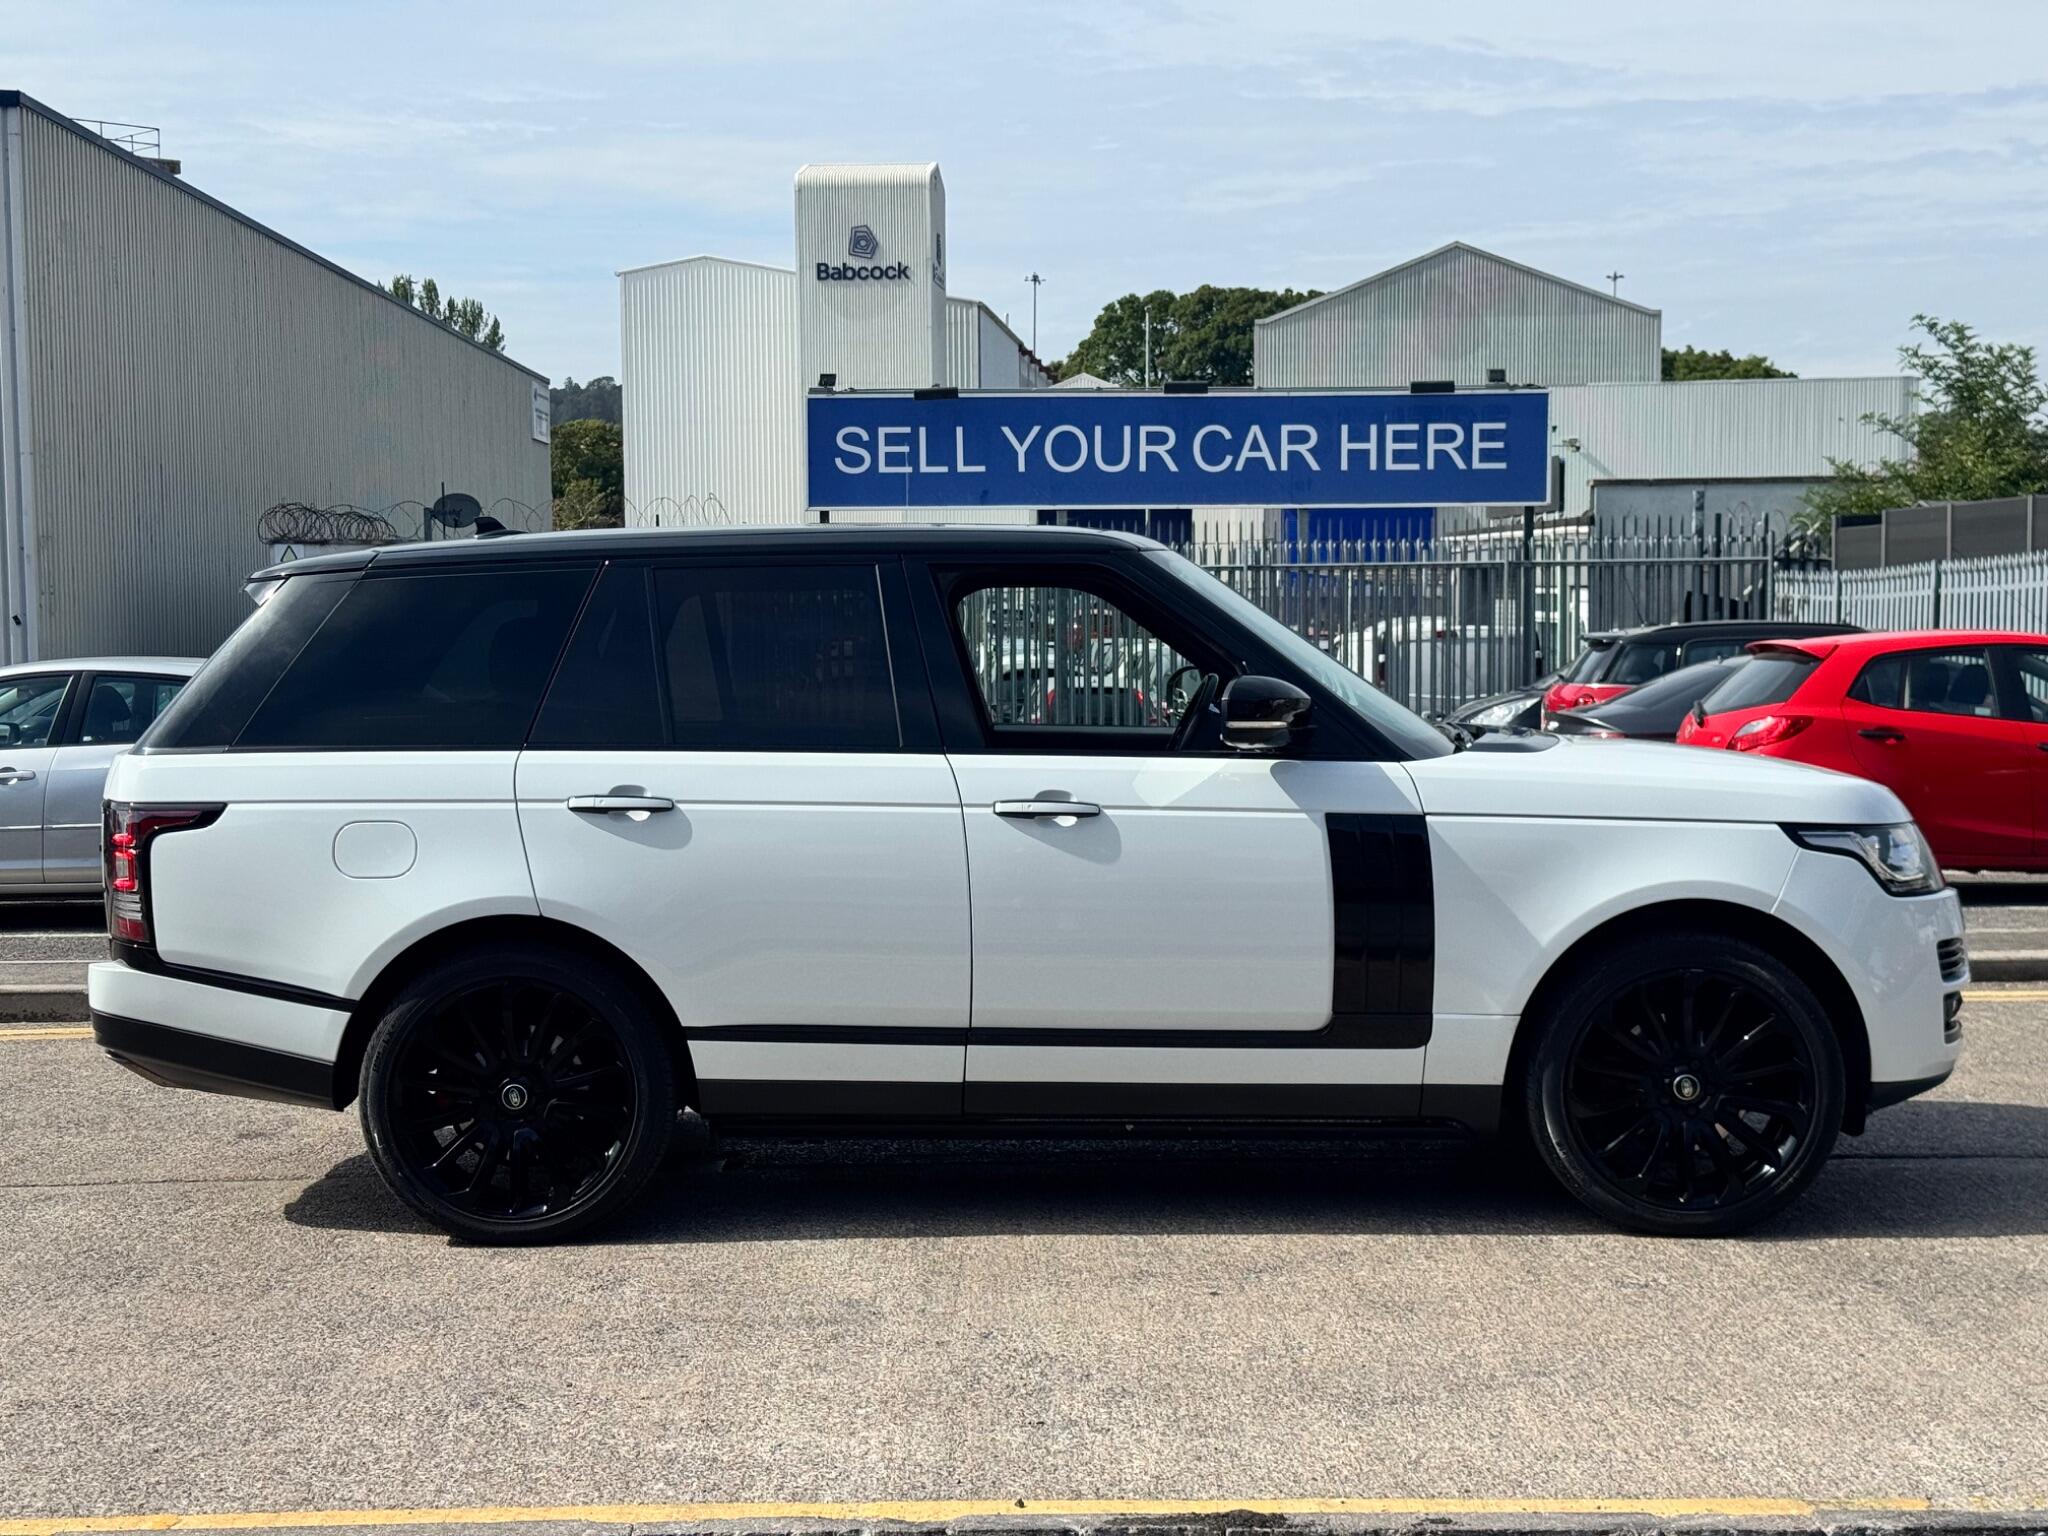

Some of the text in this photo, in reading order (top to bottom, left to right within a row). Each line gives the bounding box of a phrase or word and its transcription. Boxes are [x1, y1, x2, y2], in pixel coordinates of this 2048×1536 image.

[816, 261, 911, 282] Babcock
[834, 422, 1507, 474] SELL YOUR CAR HERE
